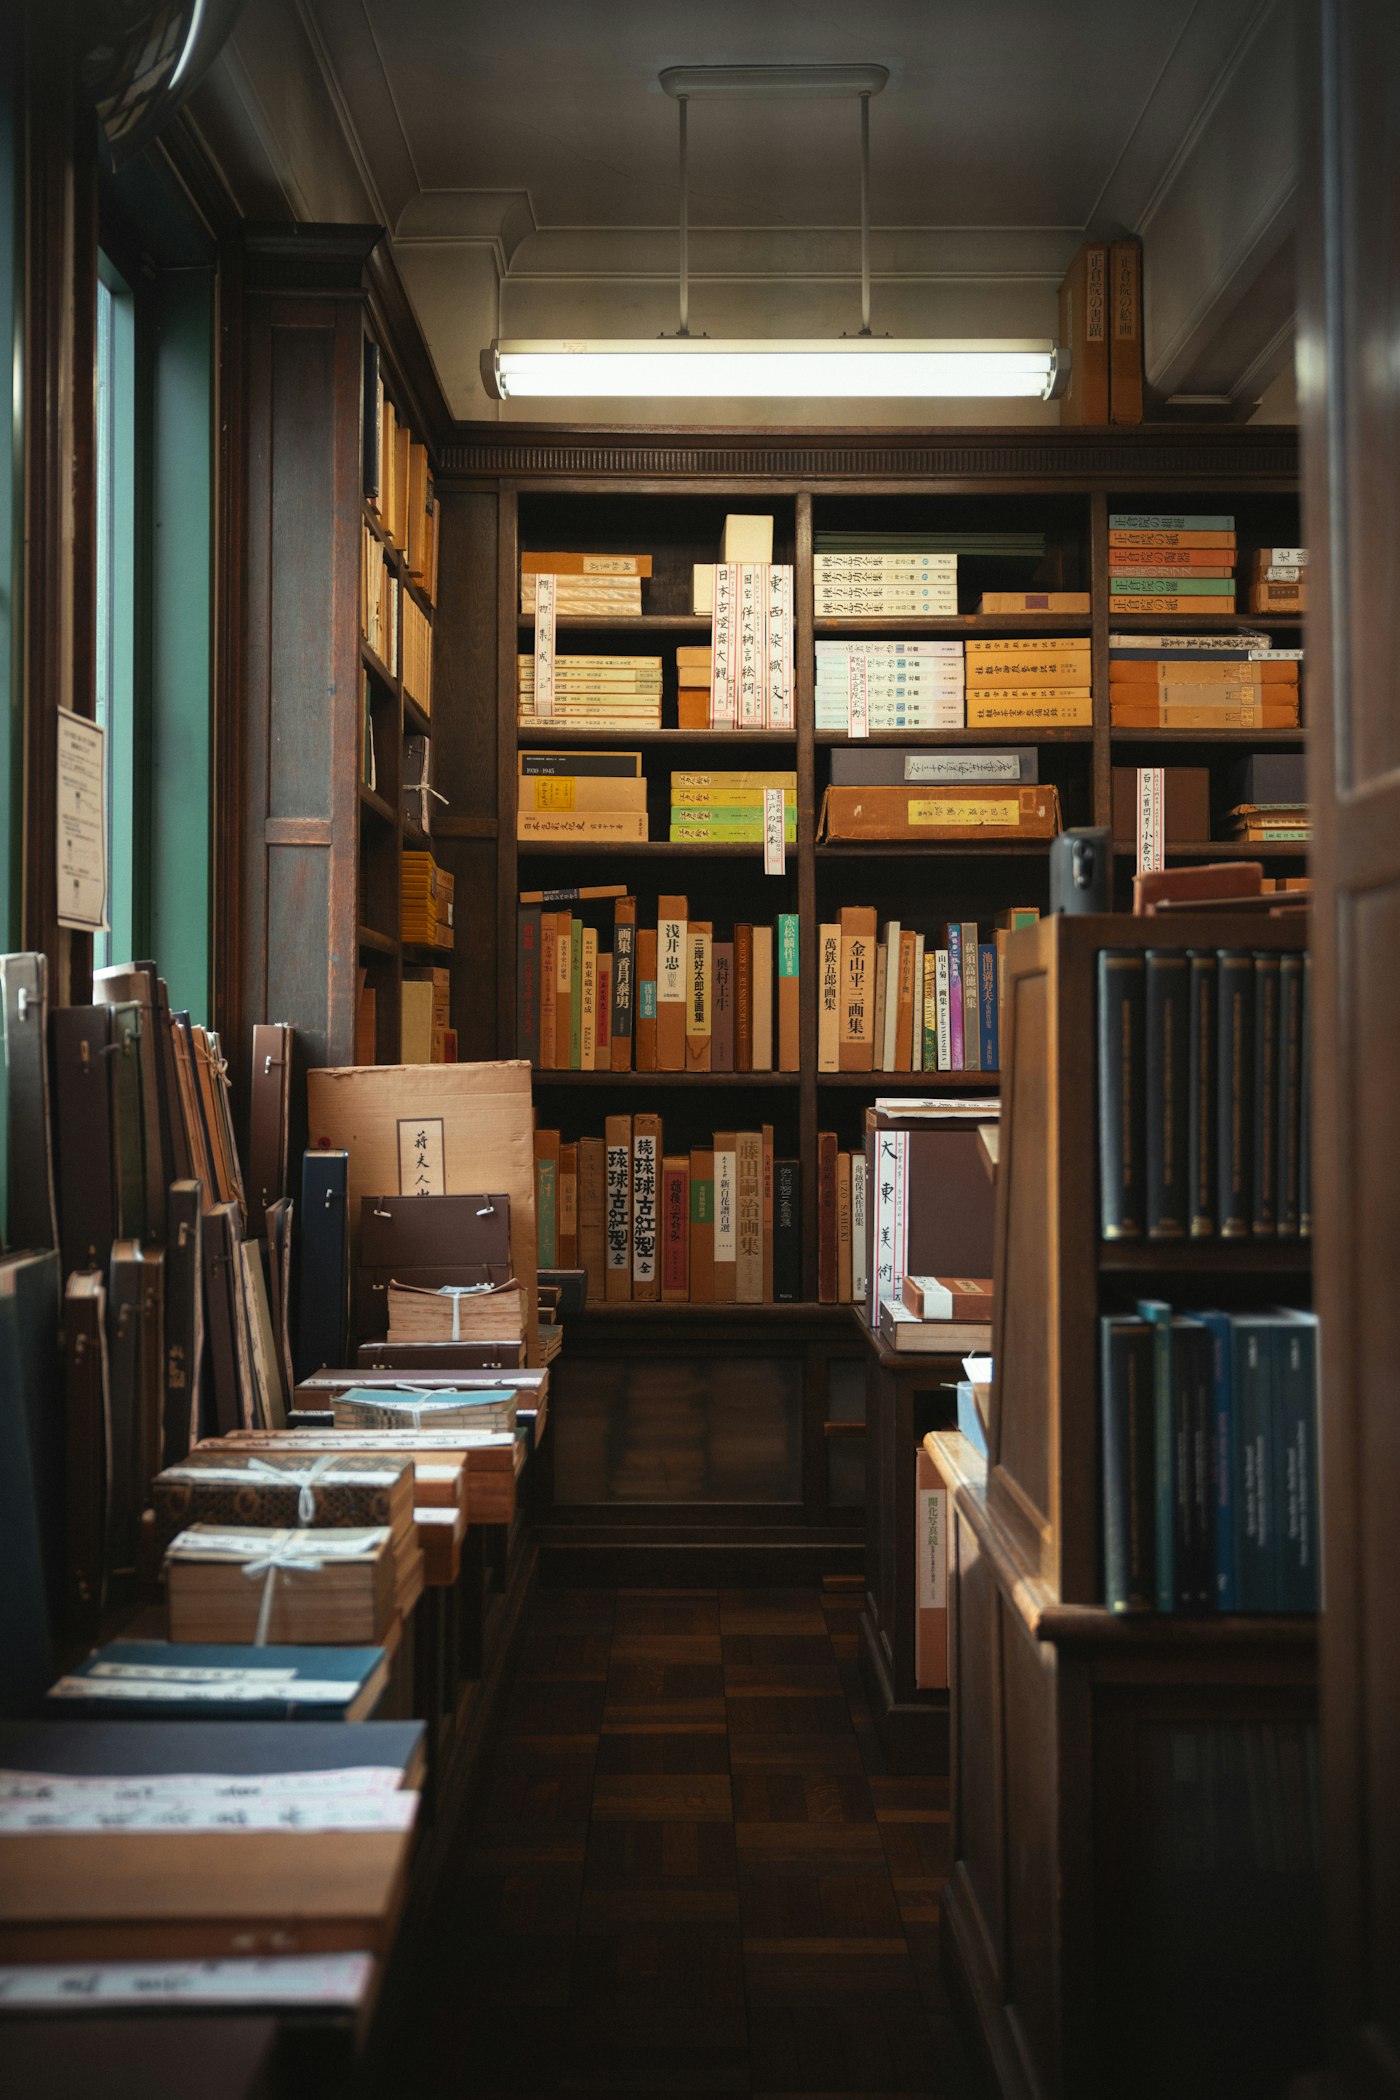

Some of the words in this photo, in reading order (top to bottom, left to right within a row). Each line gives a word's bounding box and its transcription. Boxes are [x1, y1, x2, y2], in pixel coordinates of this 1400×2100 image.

[822, 556, 883, 567] 棟方志功全集
[822, 571, 883, 583] 棟方志功全集
[822, 587, 883, 598] 棟方志功全集
[822, 602, 883, 614] 棟方志功全集
[679, 776, 711, 785] 江戸の絵本
[679, 793, 710, 802] 江戸の絵本
[524, 821, 586, 832] 日本色彩文化史
[679, 811, 711, 820] 江戸の絵本
[767, 792, 777, 844] 江戸の絵本
[678, 829, 710, 838] 江戸の絵本
[617, 928, 631, 954] 画集
[665, 923, 680, 970] 浅井忠
[584, 961, 593, 1014] 装束織文集成
[616, 957, 631, 1009] 香月泰男
[694, 939, 704, 1023] 三岸好太郎全画集
[824, 938, 837, 1011] 萬鉄五郎画集
[848, 941, 866, 1034] 金山平三画集
[739, 1140, 760, 1256] 藤田嗣治画集
[878, 1140, 898, 1283] 大東美術
